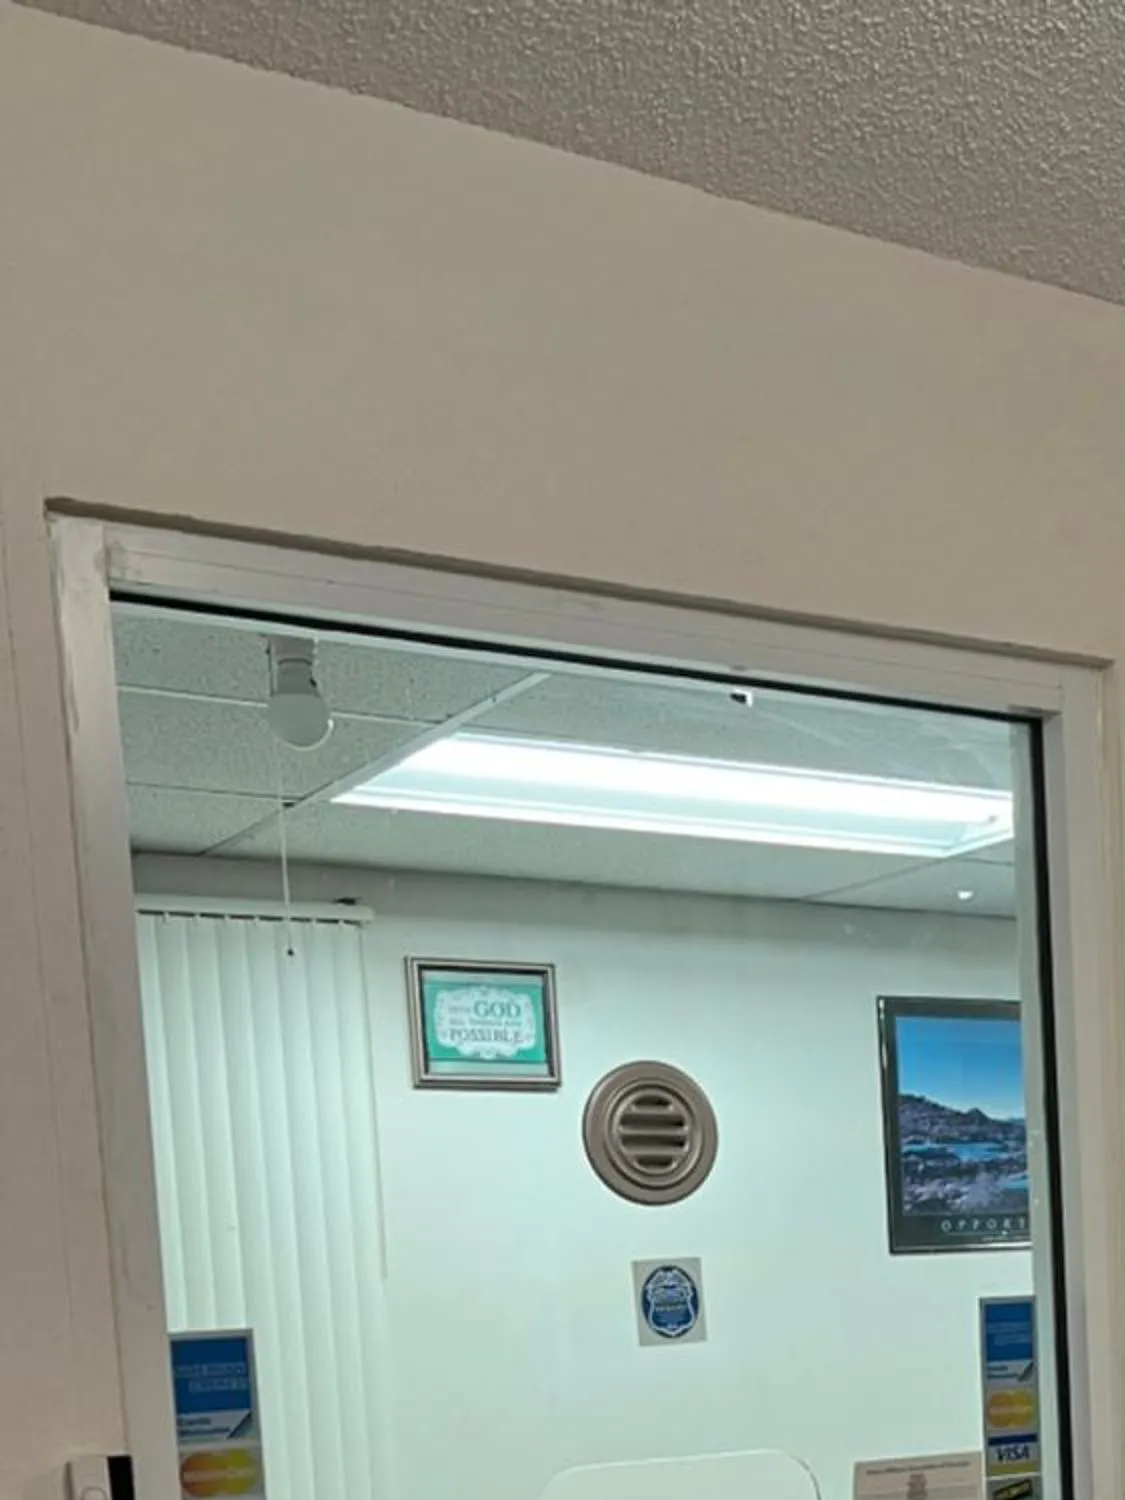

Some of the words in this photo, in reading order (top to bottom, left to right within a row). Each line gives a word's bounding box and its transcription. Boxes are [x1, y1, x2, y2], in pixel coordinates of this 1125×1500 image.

[473, 999, 521, 1018] GOD
[449, 1027, 524, 1042] POSSIBLE
[997, 1445, 1030, 1464] VISA
